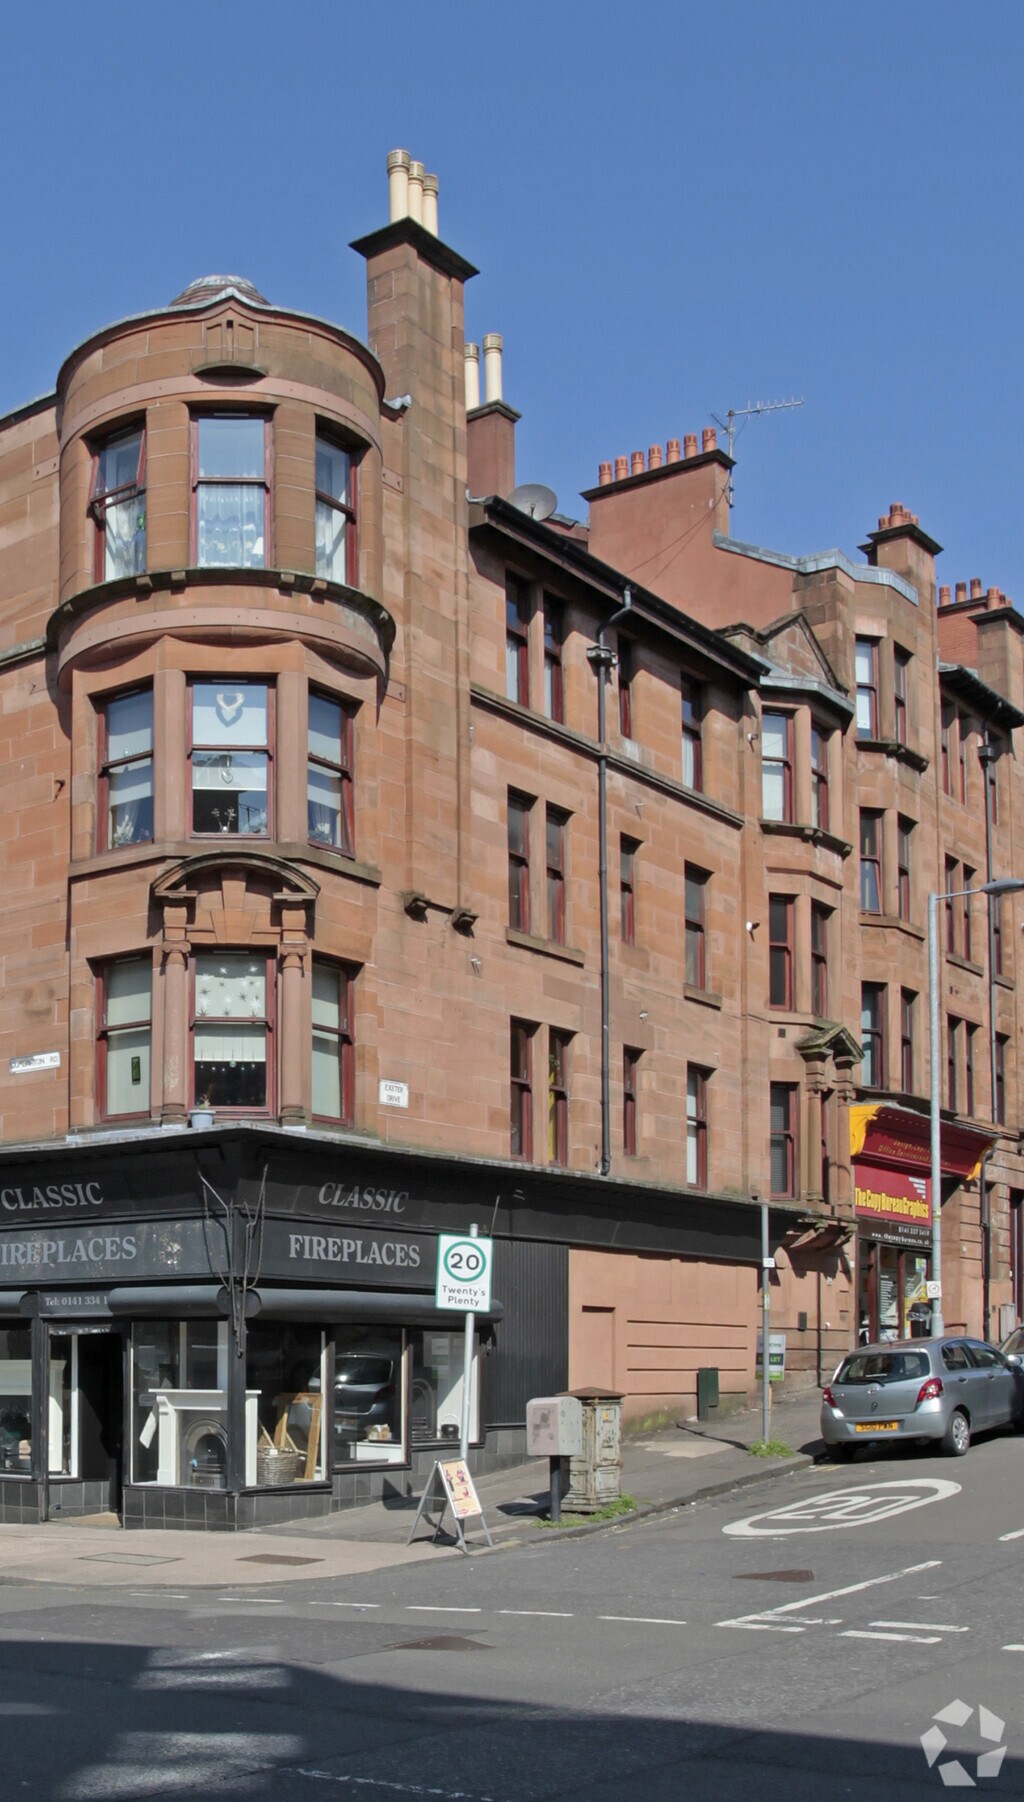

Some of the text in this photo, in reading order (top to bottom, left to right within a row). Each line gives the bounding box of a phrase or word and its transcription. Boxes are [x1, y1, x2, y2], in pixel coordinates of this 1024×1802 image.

[384, 1084, 403, 1093] EXETER
[386, 1095, 401, 1103] DRIVE
[0, 1182, 104, 1210] CLASSIC
[318, 1182, 409, 1213] CLASSIC
[854, 1187, 929, 1219] The Copy Bureau Graphics
[289, 1234, 421, 1267] FIREPLACES
[450, 1253, 480, 1271] 20
[442, 1285, 486, 1297] Twenty's
[45, 1297, 60, 1306] Tel:
[61, 1296, 82, 1305] 0141
[84, 1296, 100, 1305] 334
[447, 1295, 480, 1307] Plenty
[767, 1496, 922, 1519] 20
